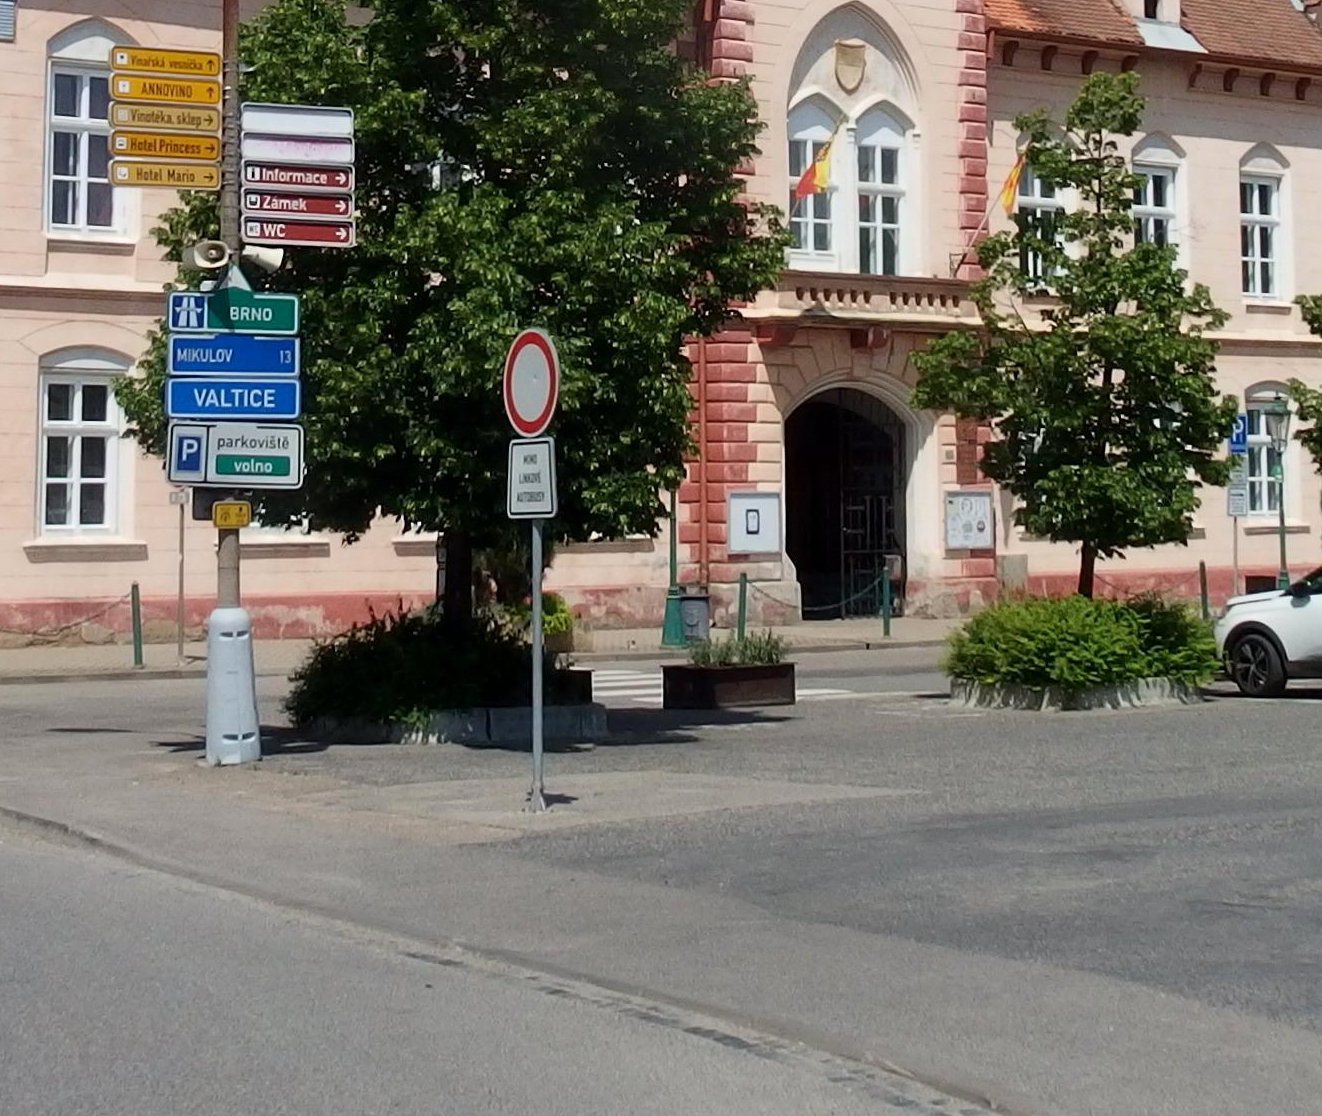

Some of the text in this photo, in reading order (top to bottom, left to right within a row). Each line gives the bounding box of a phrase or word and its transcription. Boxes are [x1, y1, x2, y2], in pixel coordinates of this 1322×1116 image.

[141, 82, 193, 98] ANNOVINO
[177, 111, 202, 129] sklep
[130, 138, 201, 154] Hotel Princess
[137, 168, 195, 183] Hotel Mario
[262, 168, 327, 184] Informace
[262, 194, 307, 211] Zámek
[262, 223, 286, 237] WC
[230, 306, 273, 321] BRNO
[177, 348, 292, 364] MIKULOV 13
[194, 388, 276, 408] VALTICE
[182, 438, 198, 462] P
[217, 435, 289, 450] parkoviště
[234, 458, 273, 473] volno
